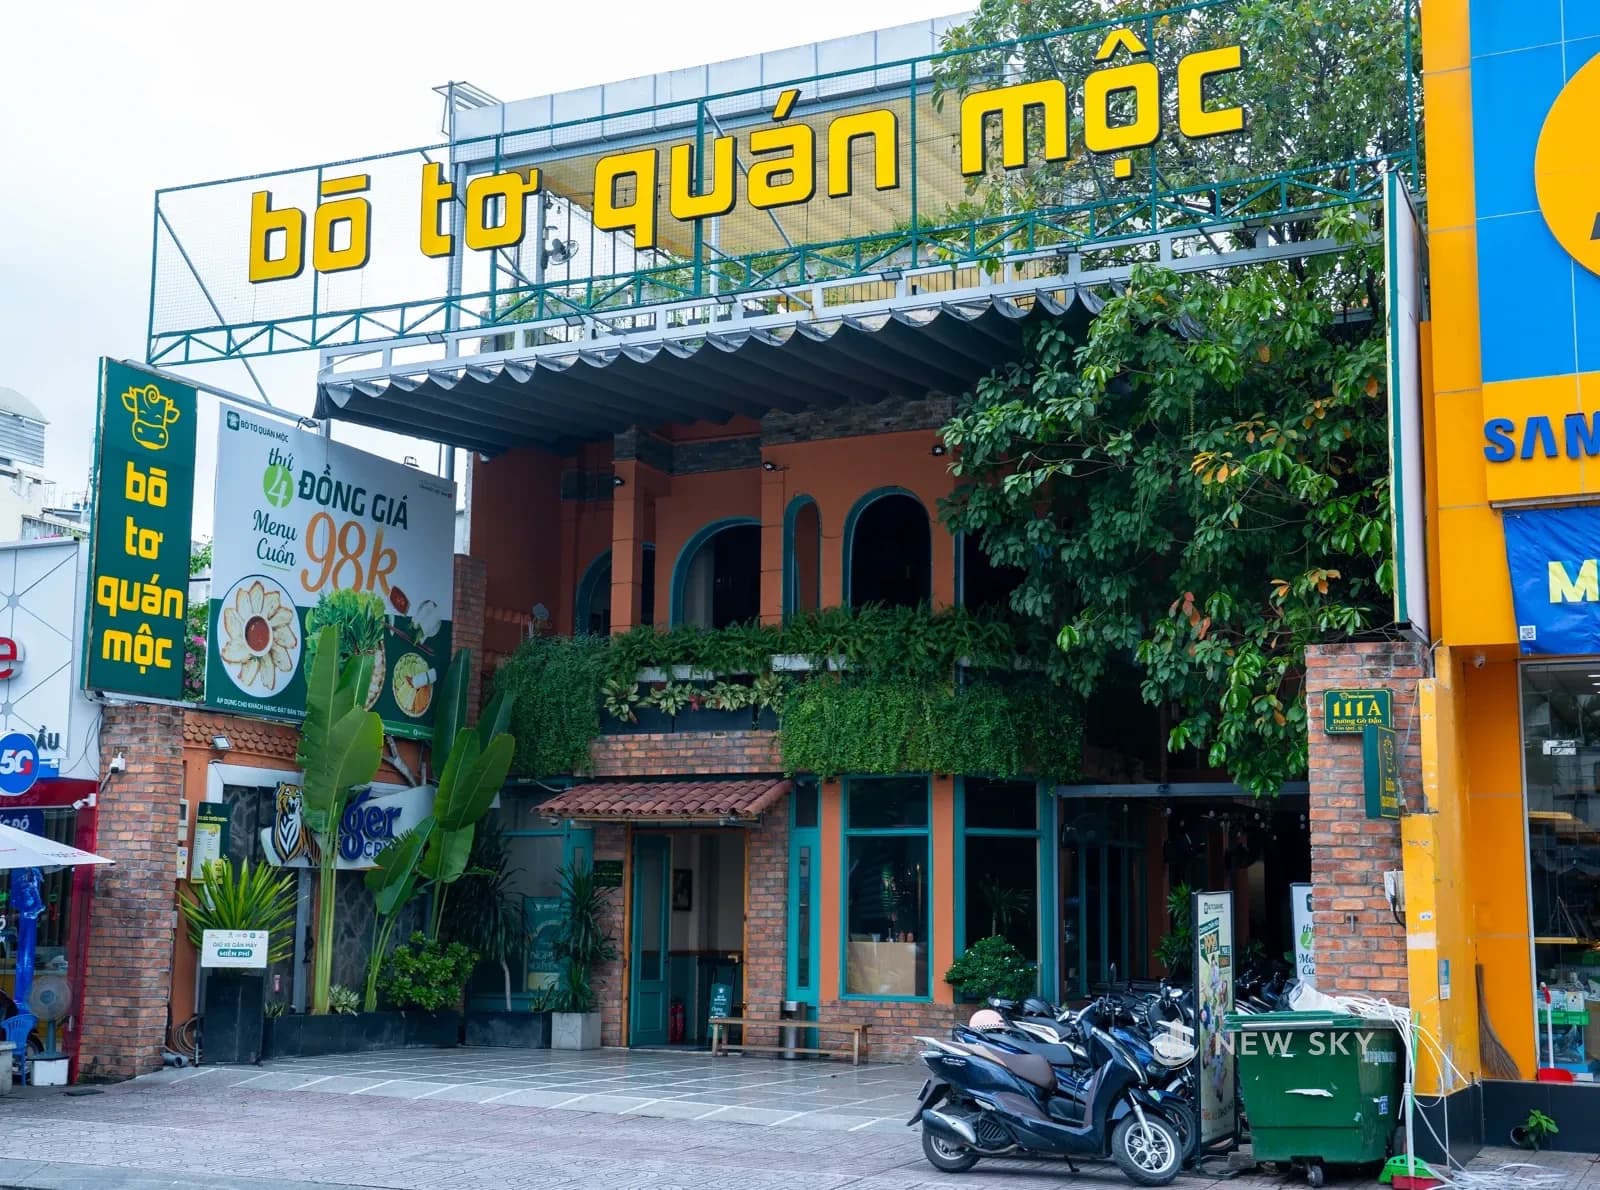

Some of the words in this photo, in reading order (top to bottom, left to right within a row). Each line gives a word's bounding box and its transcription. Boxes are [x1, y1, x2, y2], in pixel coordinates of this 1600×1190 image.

[593, 88, 900, 250] quán
[960, 28, 1245, 180] mộc
[267, 465, 288, 508] 4
[298, 464, 367, 517] ĐỒNG
[371, 494, 408, 531] GIÁ
[253, 509, 298, 541] Menu
[256, 537, 297, 567] Cuốn
[97, 573, 184, 620] quán
[102, 623, 173, 674] mộc
[1333, 700, 1382, 717] 111A
